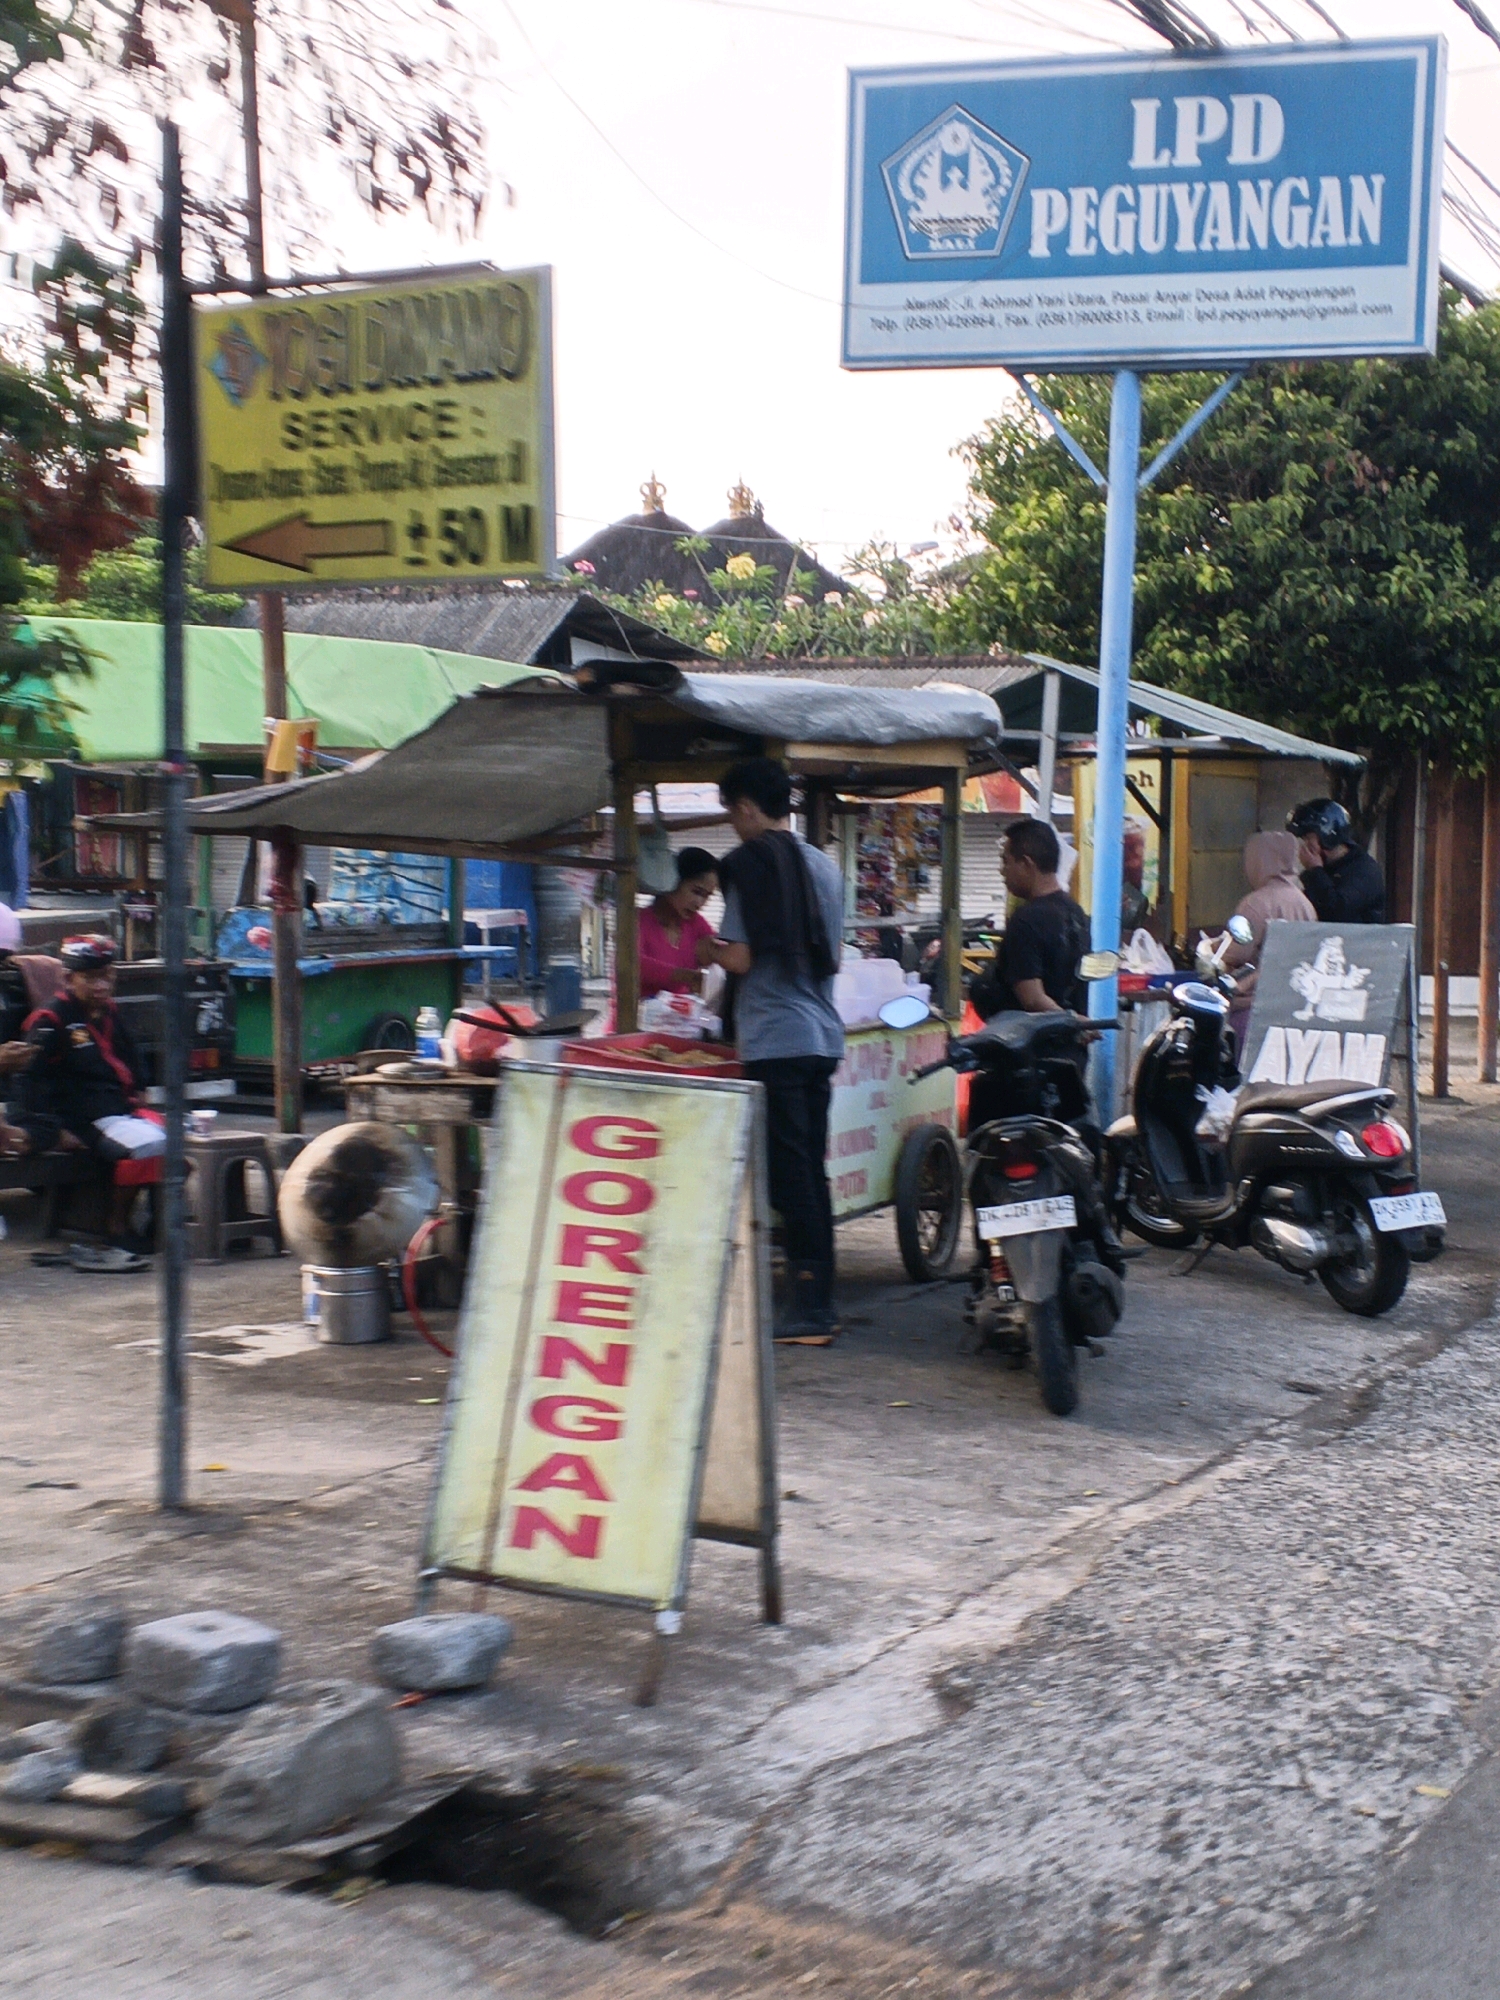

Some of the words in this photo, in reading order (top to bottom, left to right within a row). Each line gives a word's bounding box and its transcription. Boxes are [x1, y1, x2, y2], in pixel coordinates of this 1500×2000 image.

[1129, 94, 1285, 170] LPD
[1028, 173, 1386, 258] PEGUYANGAN
[280, 400, 460, 452] SERVICE
[506, 1115, 665, 1560] GORENGAN
